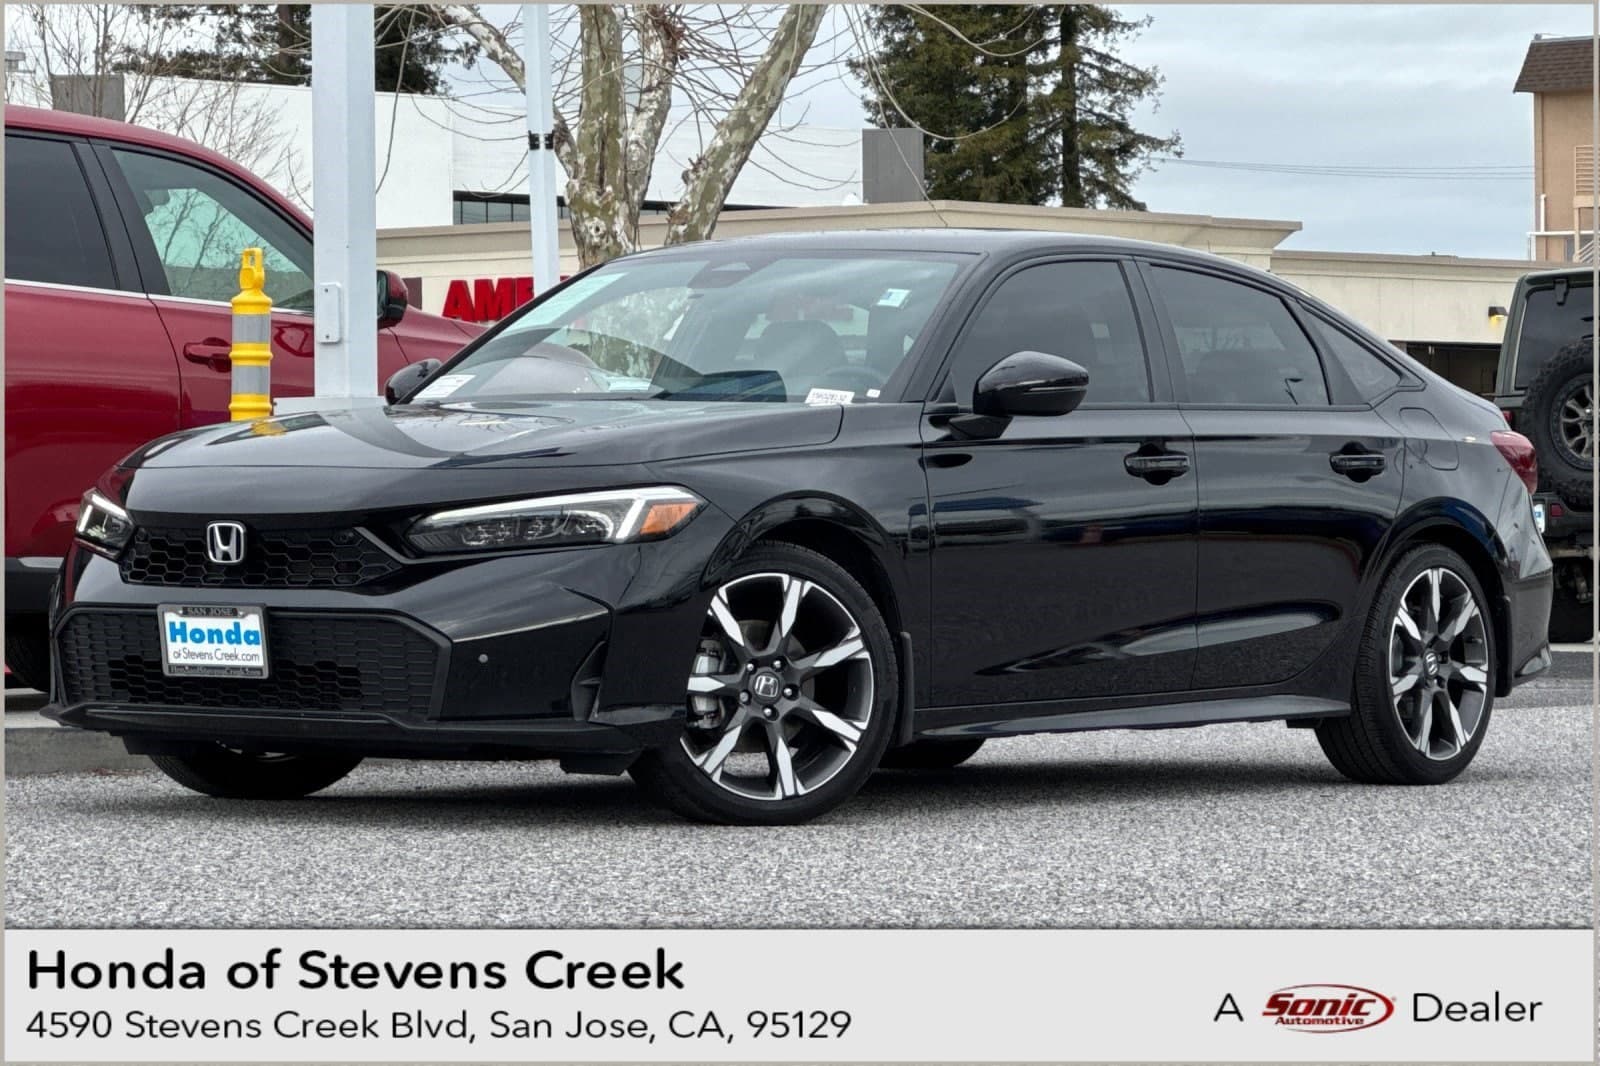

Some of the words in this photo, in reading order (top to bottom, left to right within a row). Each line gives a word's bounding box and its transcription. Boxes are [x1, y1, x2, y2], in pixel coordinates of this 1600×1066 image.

[168, 621, 261, 645] Honda
[172, 648, 182, 660] of
[182, 647, 214, 661] Stevens
[214, 647, 261, 662] Creek.com
